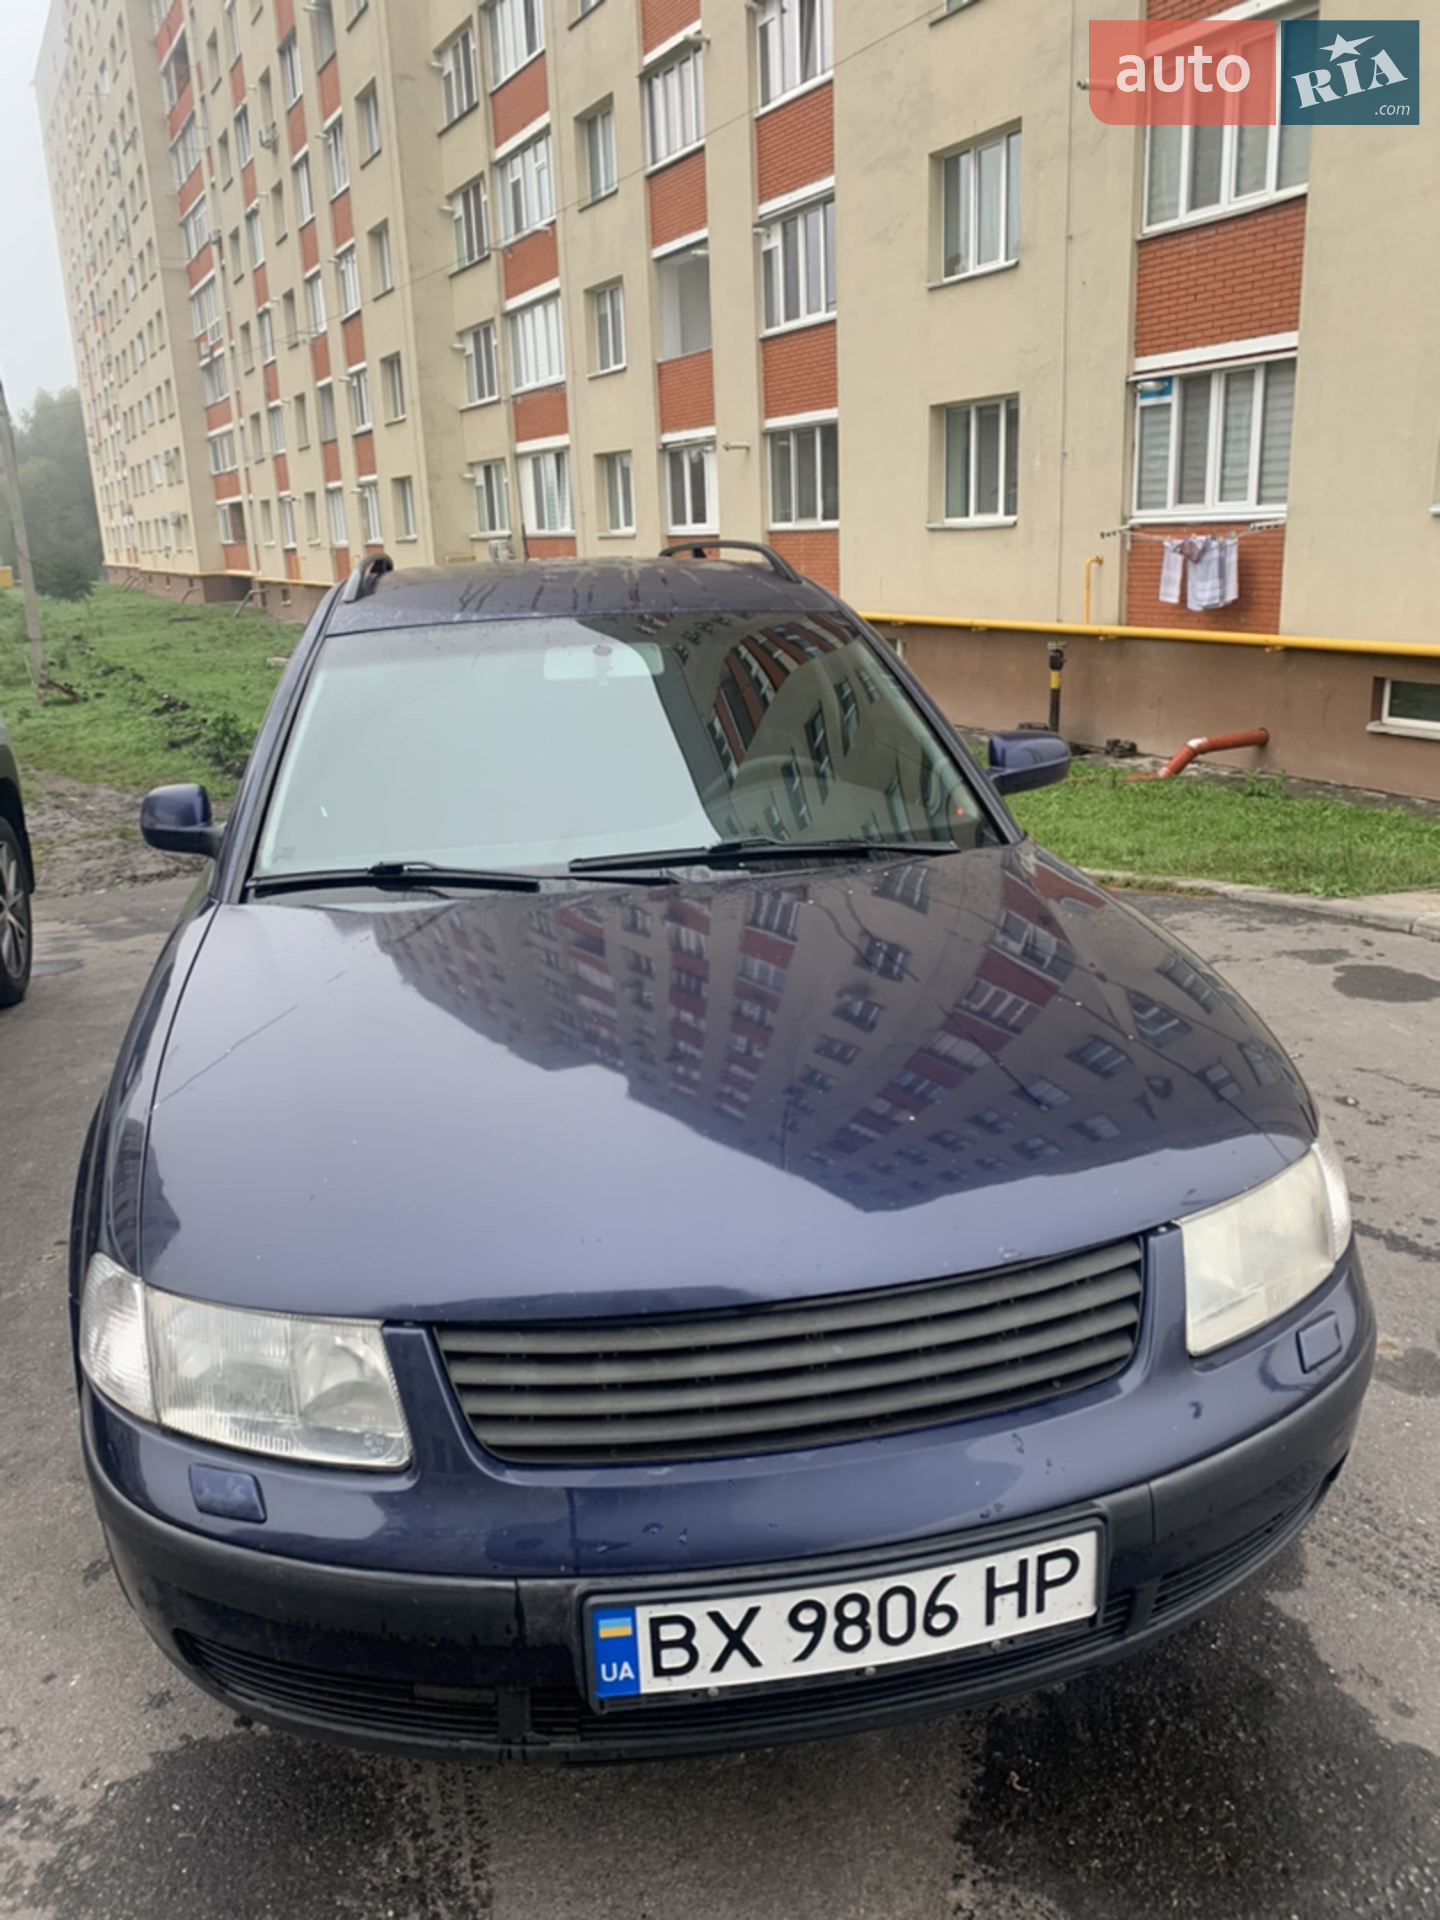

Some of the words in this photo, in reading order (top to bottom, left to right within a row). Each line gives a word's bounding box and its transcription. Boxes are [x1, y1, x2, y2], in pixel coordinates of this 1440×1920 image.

[648, 1605, 764, 1678] BX
[786, 1573, 957, 1664] 9806
[984, 1546, 1081, 1627] HP
[601, 1660, 635, 1683] UA
